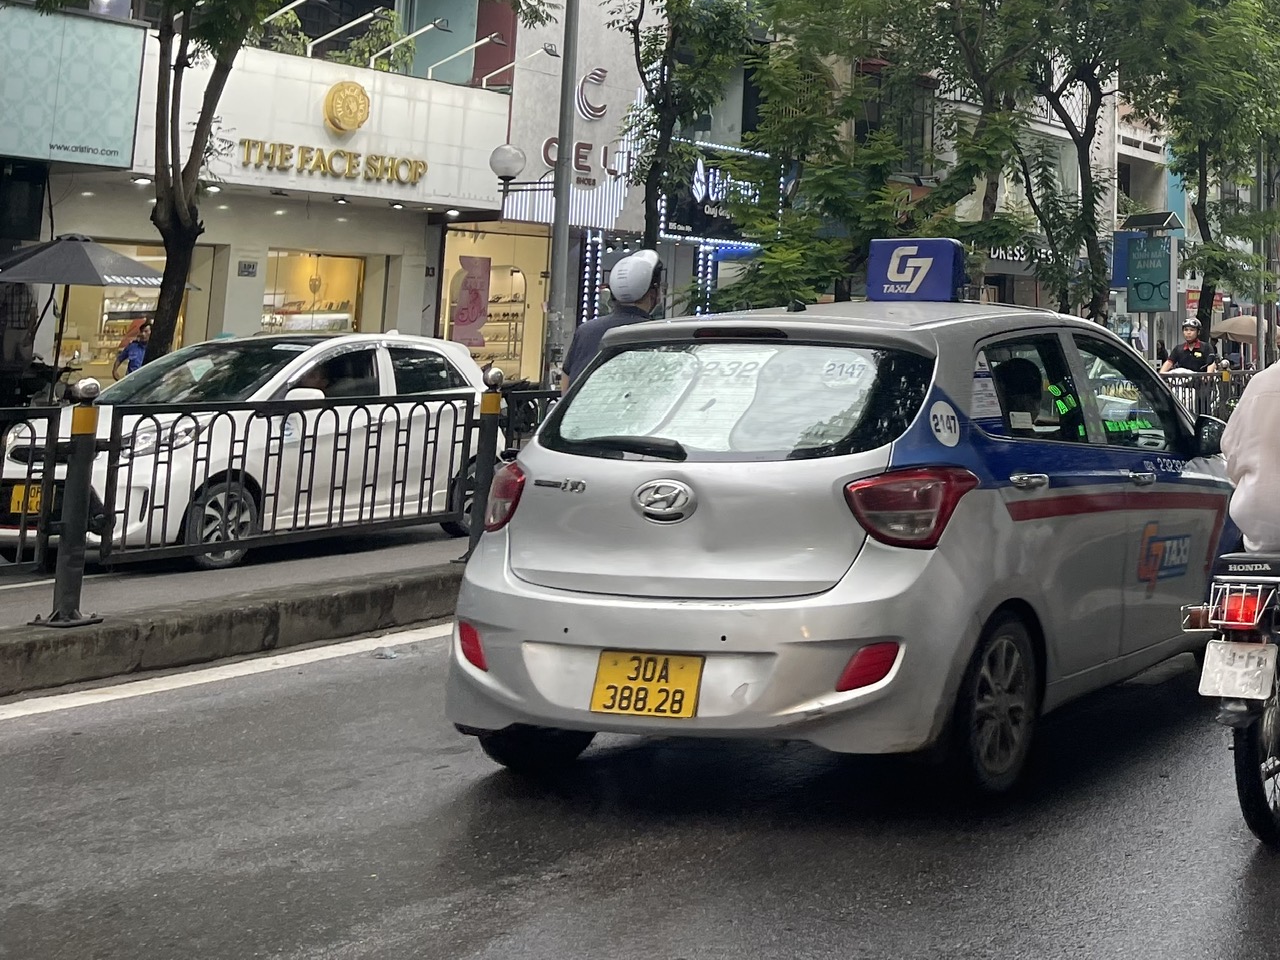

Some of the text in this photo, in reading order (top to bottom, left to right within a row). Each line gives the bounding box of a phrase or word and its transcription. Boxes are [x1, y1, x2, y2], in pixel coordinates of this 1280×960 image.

[49, 143, 119, 157] www.aristino.com
[240, 138, 428, 186] THE FACE SHOP
[990, 245, 1026, 262] DRESS
[887, 246, 934, 294] G7
[1136, 259, 1162, 269] ANNA
[103, 274, 163, 286] ARISTIN
[883, 284, 908, 293] TAXI
[824, 361, 867, 379] 2147
[931, 413, 957, 434] 2147
[1164, 537, 1191, 567] TAXI
[1228, 563, 1271, 572] HONDA
[627, 655, 670, 683] 30A
[602, 684, 685, 714] 388.28
